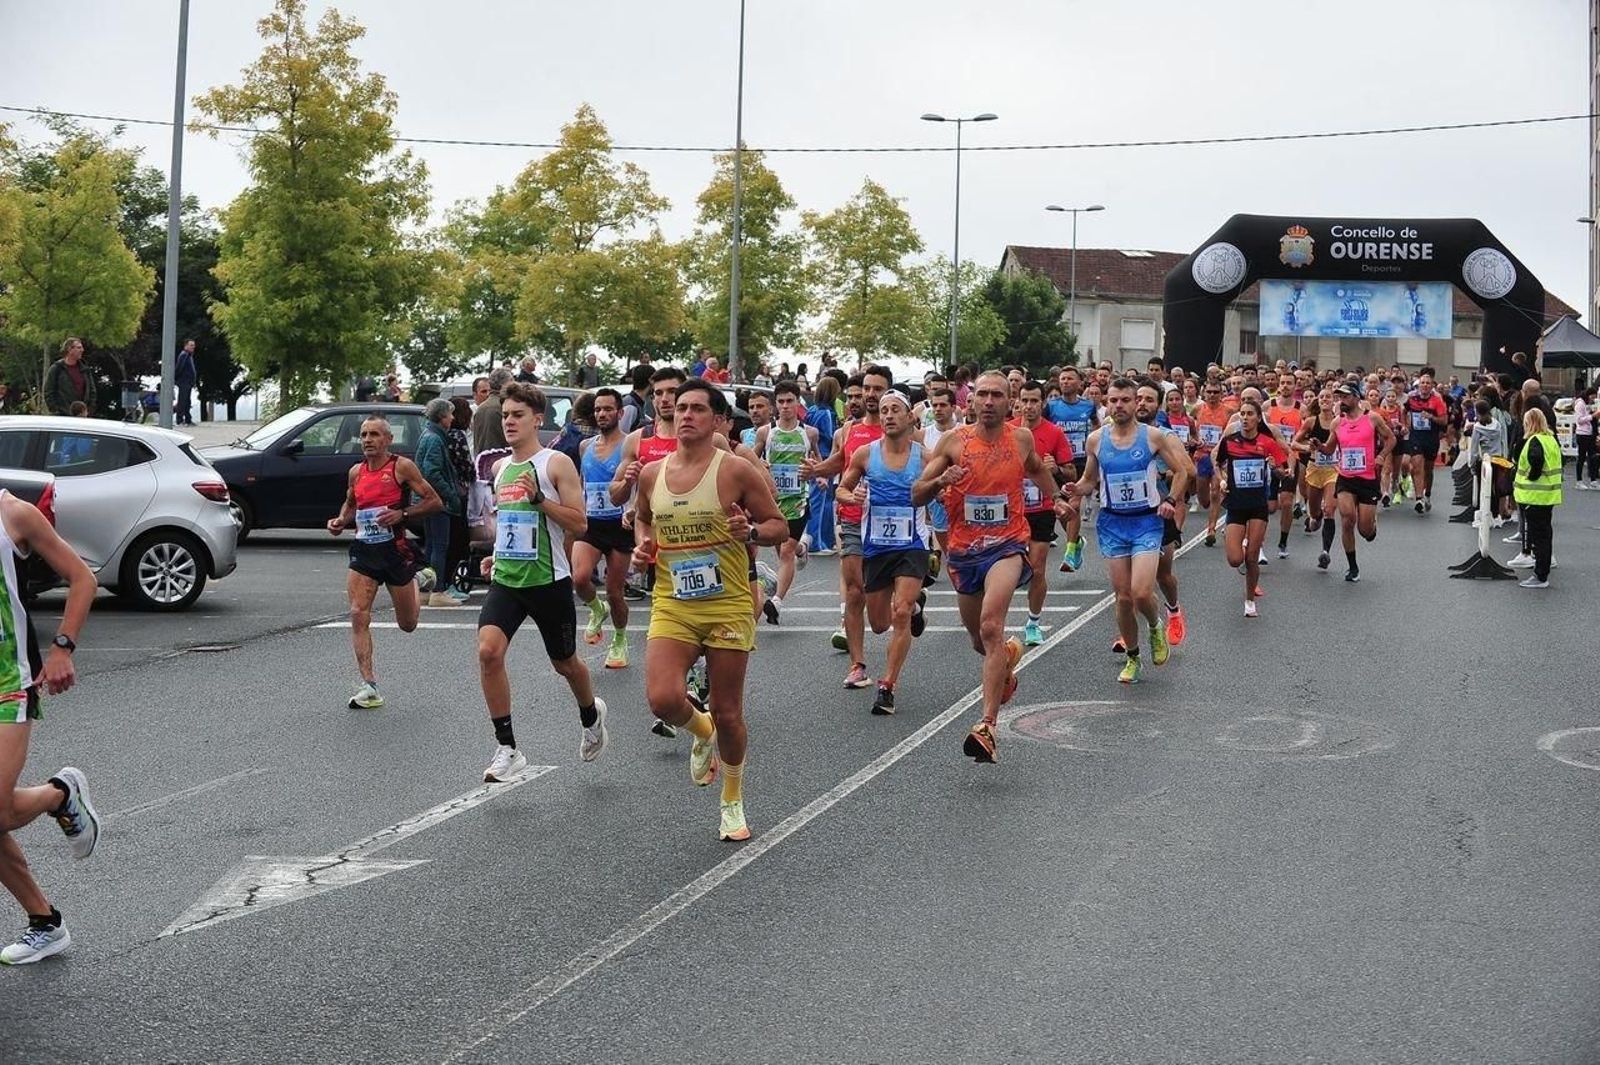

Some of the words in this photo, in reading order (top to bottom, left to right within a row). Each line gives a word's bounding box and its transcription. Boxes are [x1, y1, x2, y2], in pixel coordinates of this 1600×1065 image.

[1330, 225, 1395, 238] Concello
[1400, 226, 1418, 238] de
[1330, 241, 1433, 260] OURENSE
[1362, 264, 1401, 272] Deportes
[774, 476, 794, 488] 3001
[1240, 471, 1256, 482] 602
[1120, 488, 1135, 502] 32
[598, 496, 604, 509] 3
[974, 509, 995, 520] 830
[882, 524, 897, 538] 22
[506, 532, 514, 550] 2
[681, 574, 705, 591] 709
